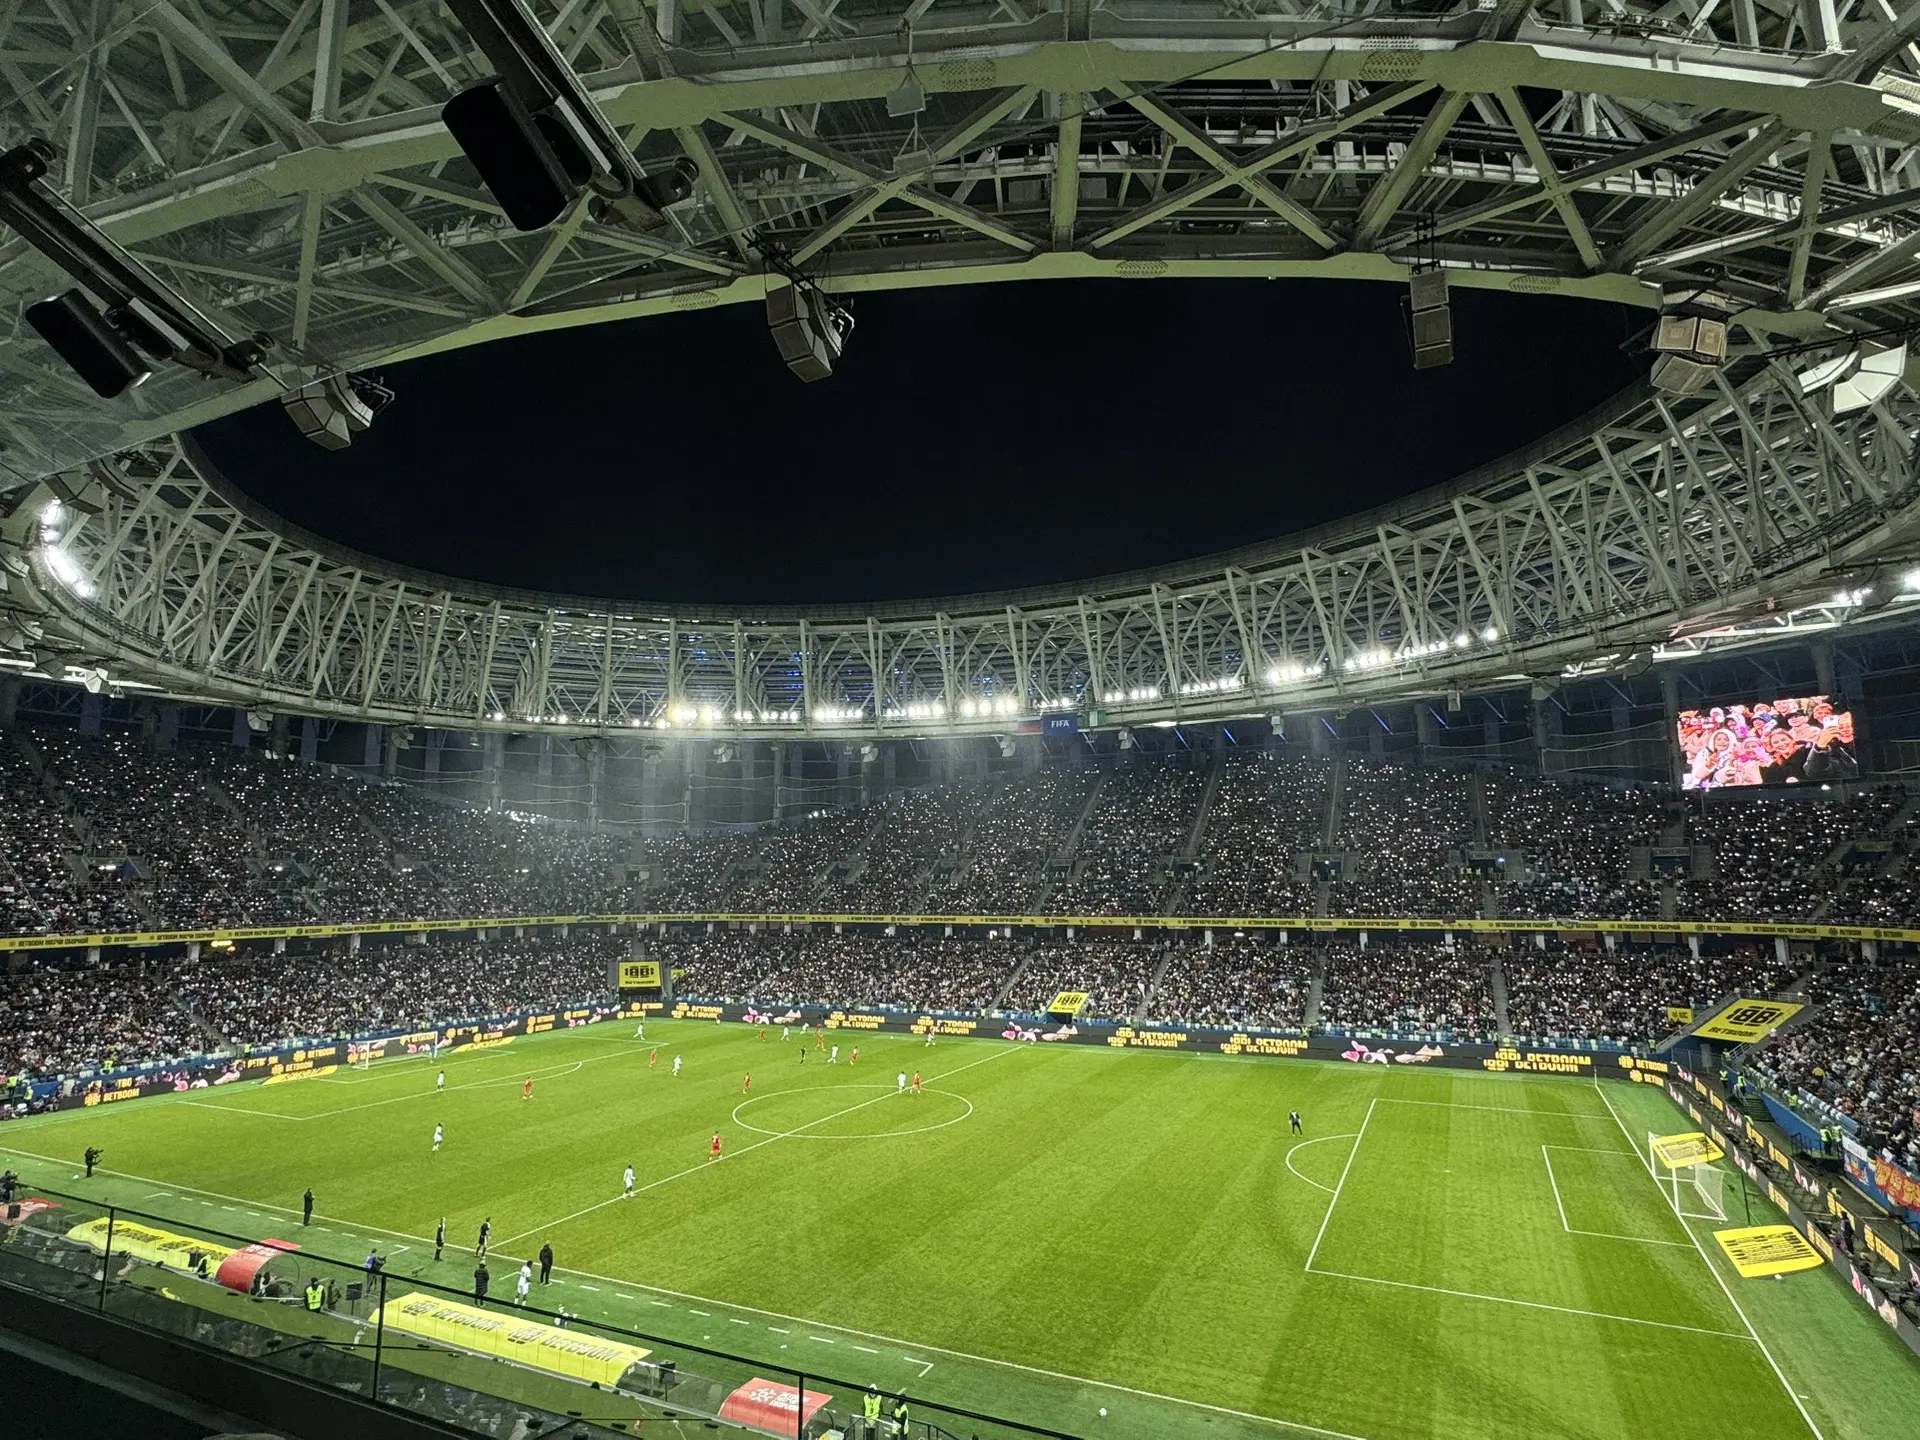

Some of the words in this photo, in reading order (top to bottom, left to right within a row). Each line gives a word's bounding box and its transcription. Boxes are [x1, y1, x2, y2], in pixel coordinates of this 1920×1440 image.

[1051, 719, 1070, 728] FIFA
[1706, 1026, 1757, 1038] BETBOOM
[103, 1087, 140, 1102] BETBOOM
[540, 1334, 623, 1362] BETBOOM
